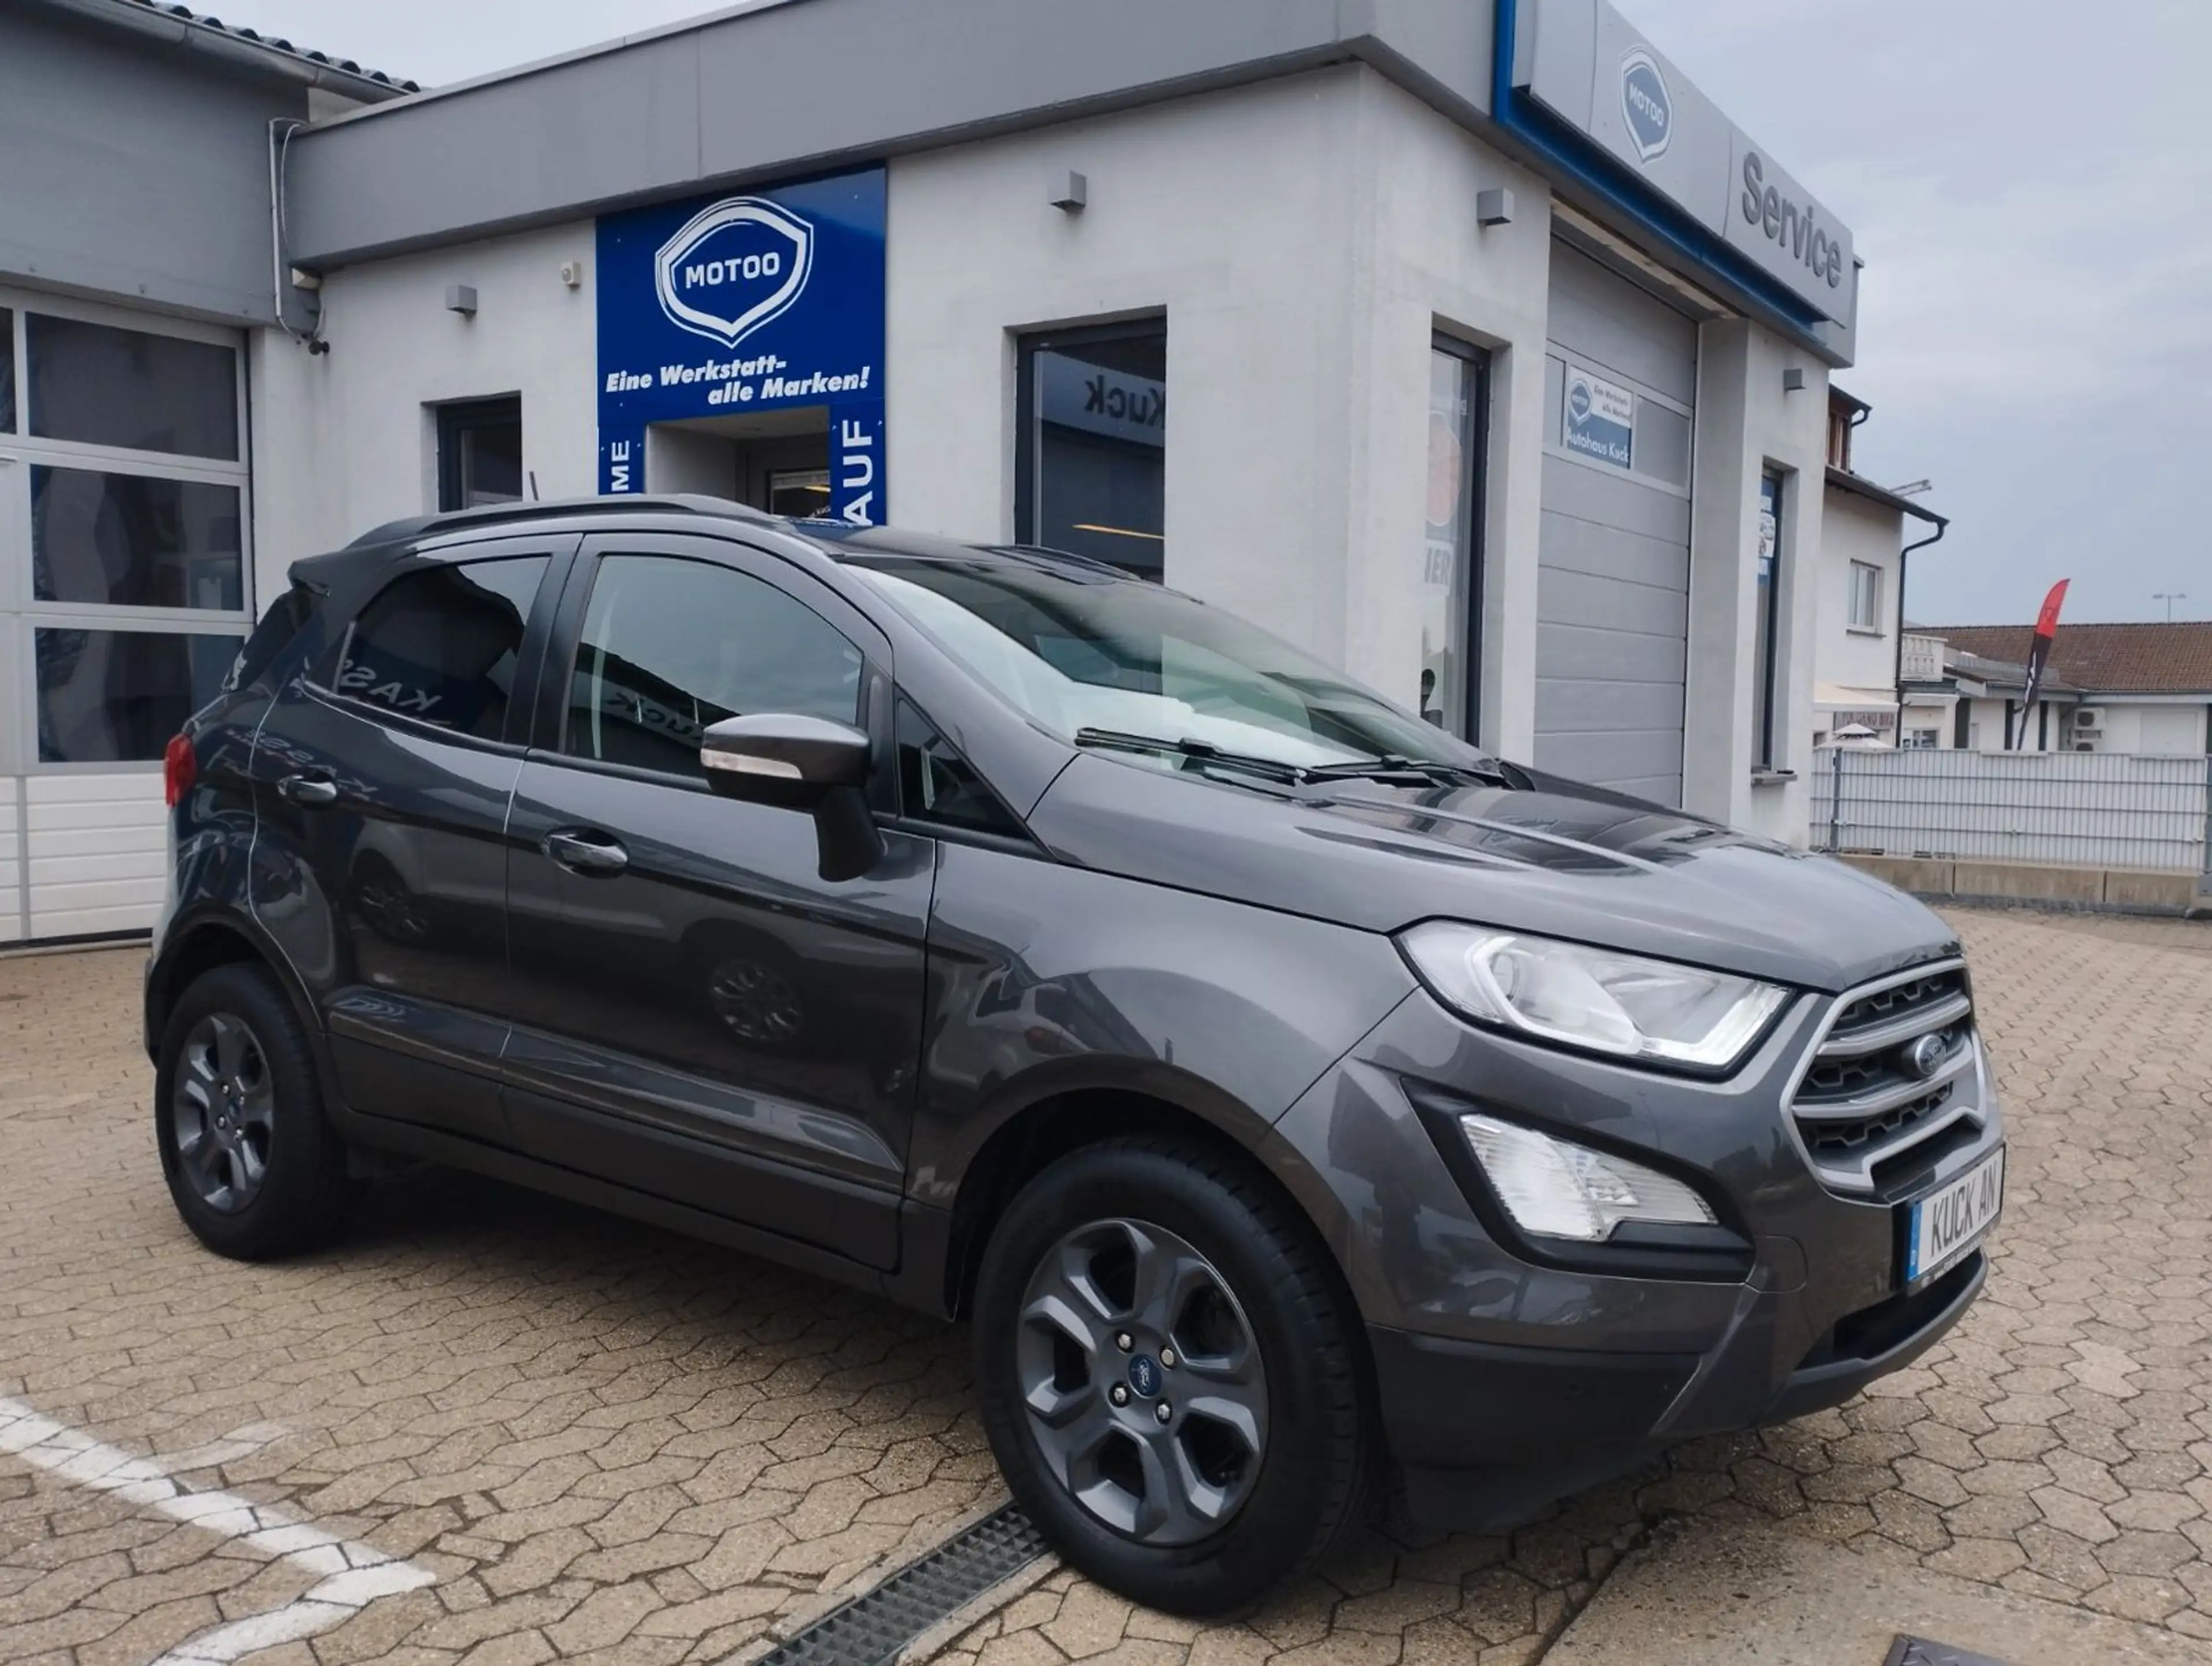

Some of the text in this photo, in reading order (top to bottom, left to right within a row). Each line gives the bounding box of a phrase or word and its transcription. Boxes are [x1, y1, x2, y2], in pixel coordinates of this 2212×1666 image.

[1628, 83, 1665, 127] MOTOO
[1741, 151, 1842, 289] Service
[685, 251, 781, 289] MOTOO
[605, 354, 787, 393] Eine Werkstatt-
[708, 367, 870, 406] alle Marken!
[1567, 427, 1629, 463] Autohaus Kuck
[842, 419, 873, 526] AUF
[1931, 1160, 1997, 1258] KUCK AN
